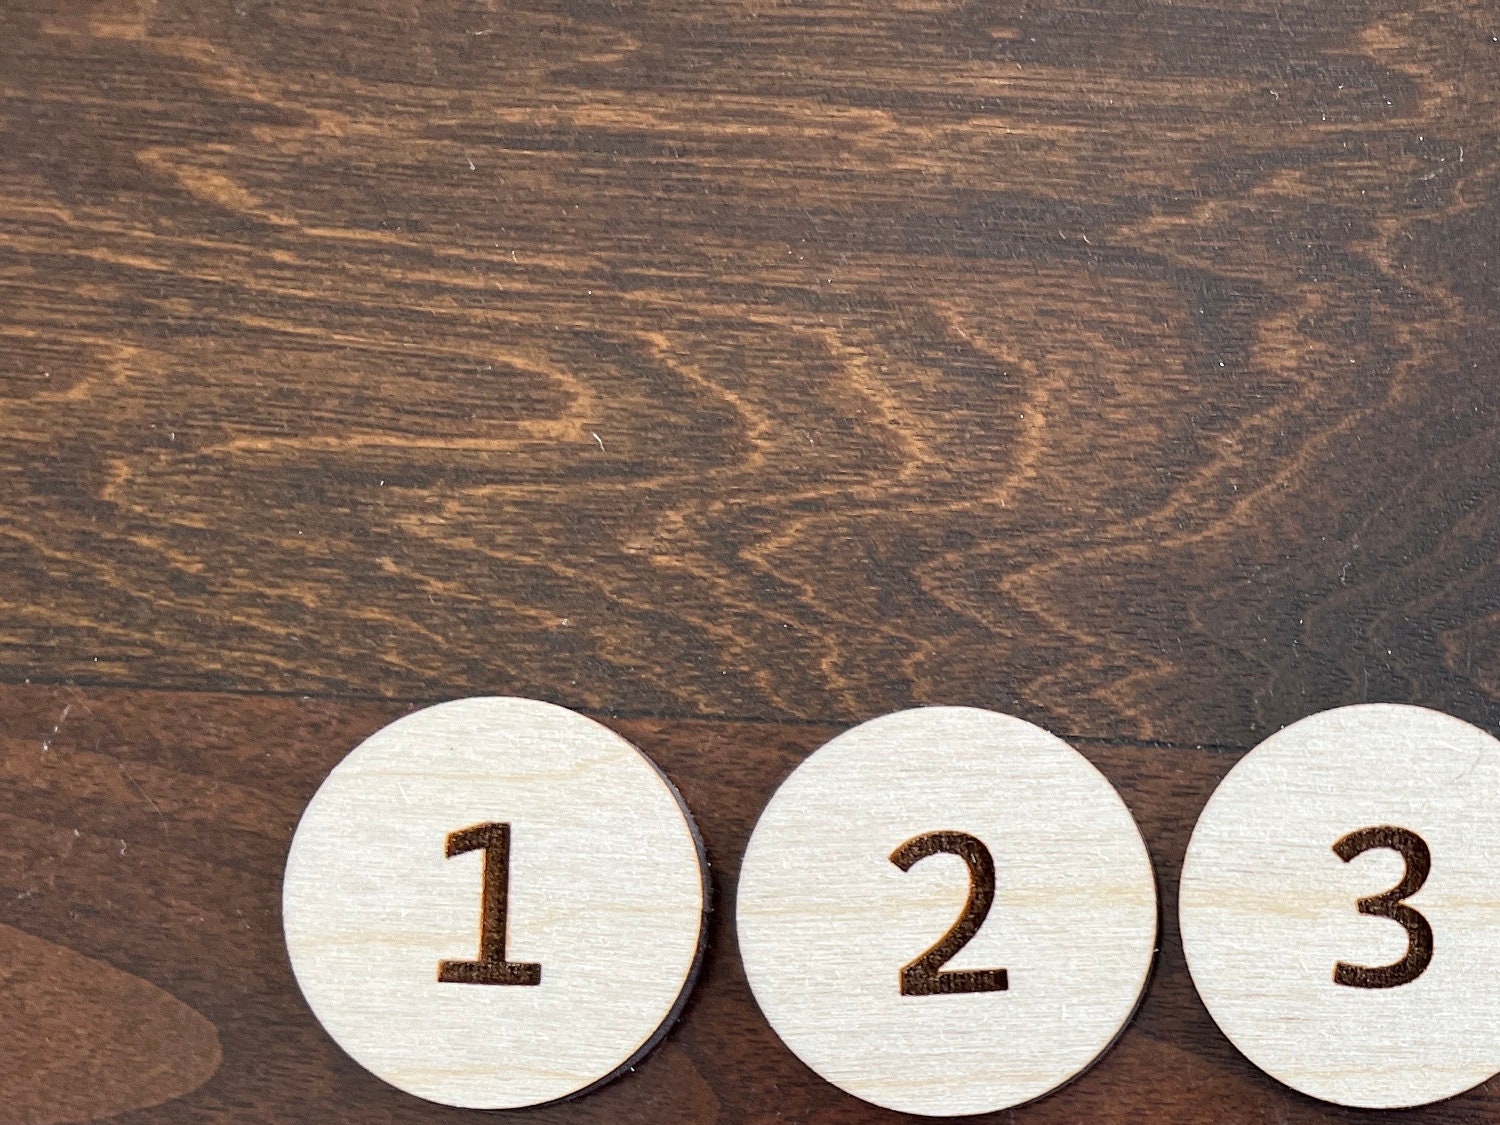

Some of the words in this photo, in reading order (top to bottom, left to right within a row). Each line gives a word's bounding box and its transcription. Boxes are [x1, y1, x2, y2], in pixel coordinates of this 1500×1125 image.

[438, 823, 541, 986] 1
[889, 831, 1008, 996] 2
[1333, 826, 1433, 989] 3
